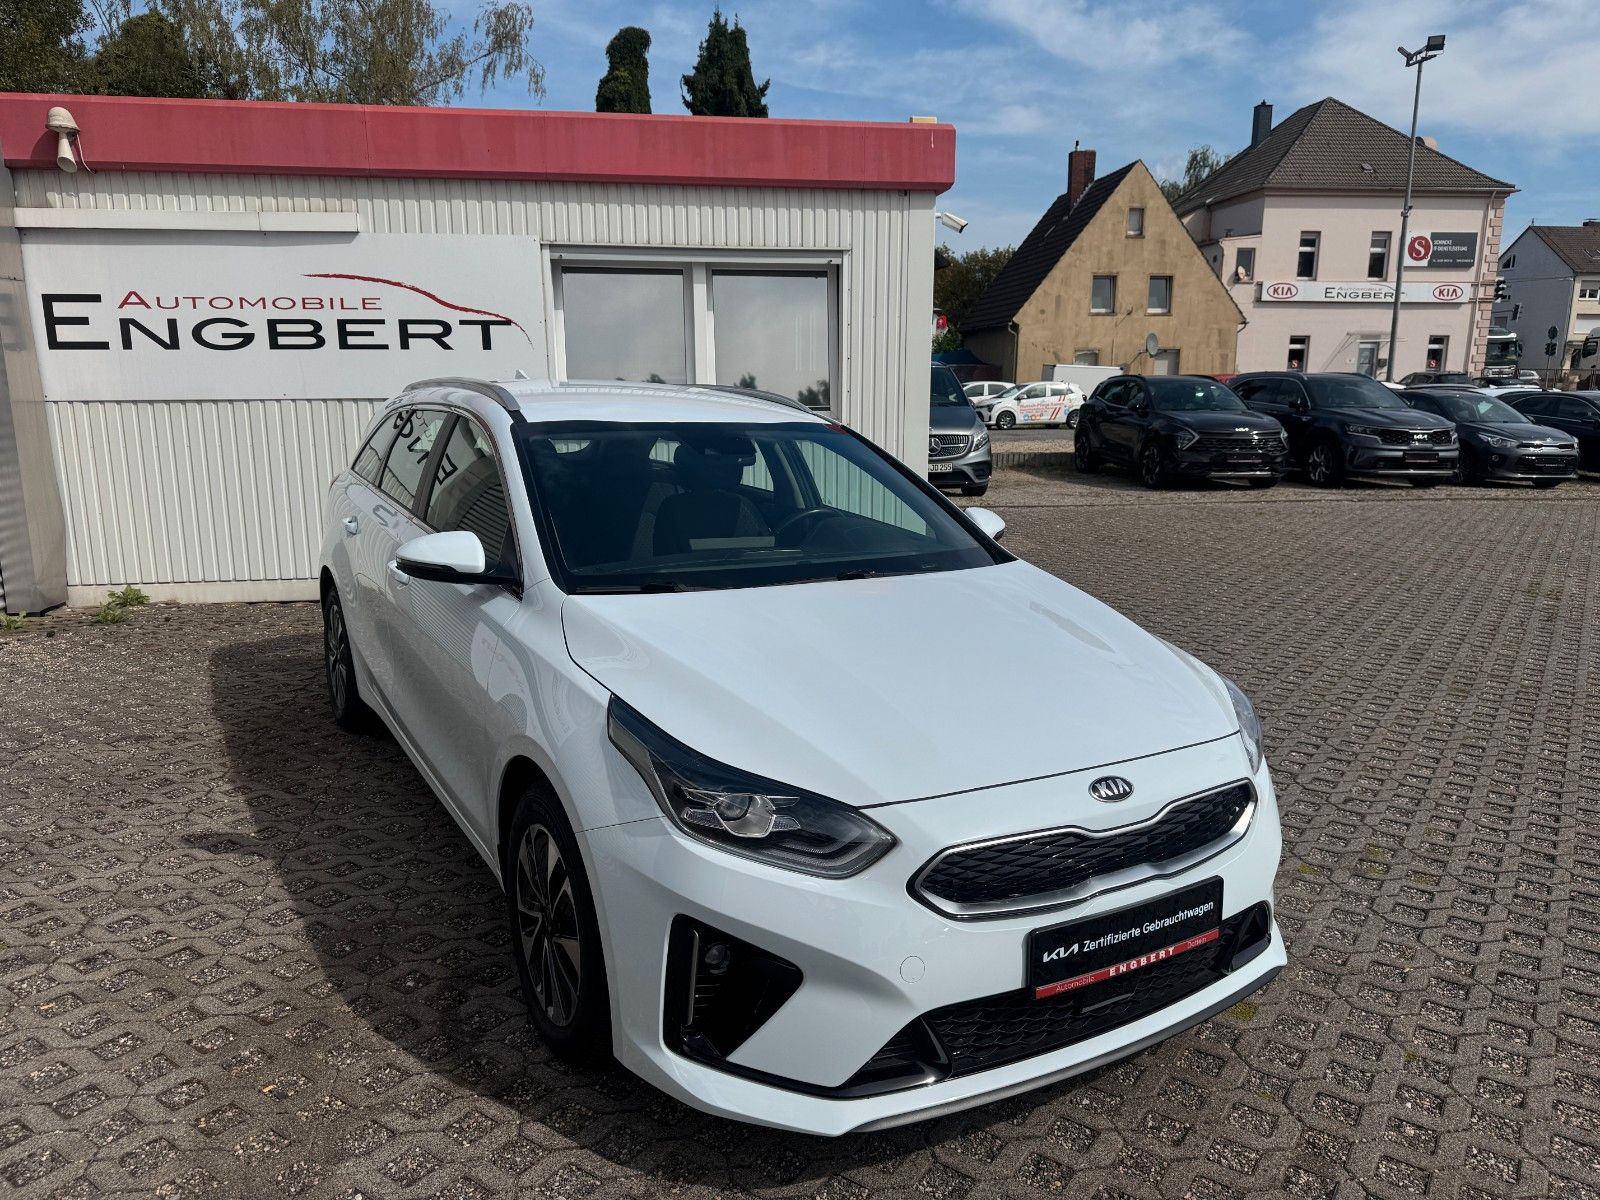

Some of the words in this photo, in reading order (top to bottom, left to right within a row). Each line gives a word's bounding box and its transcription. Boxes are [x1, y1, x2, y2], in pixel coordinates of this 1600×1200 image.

[117, 290, 382, 311] AUTOMOBILE
[1324, 287, 1405, 299] ENGBER
[42, 293, 512, 351] ENGBERT
[1083, 927, 1141, 952] Zertifizierte
[1142, 900, 1215, 934] Gebrauchtwagen
[1055, 975, 1095, 992] Automobile
[1109, 946, 1175, 977] ENGBERT
